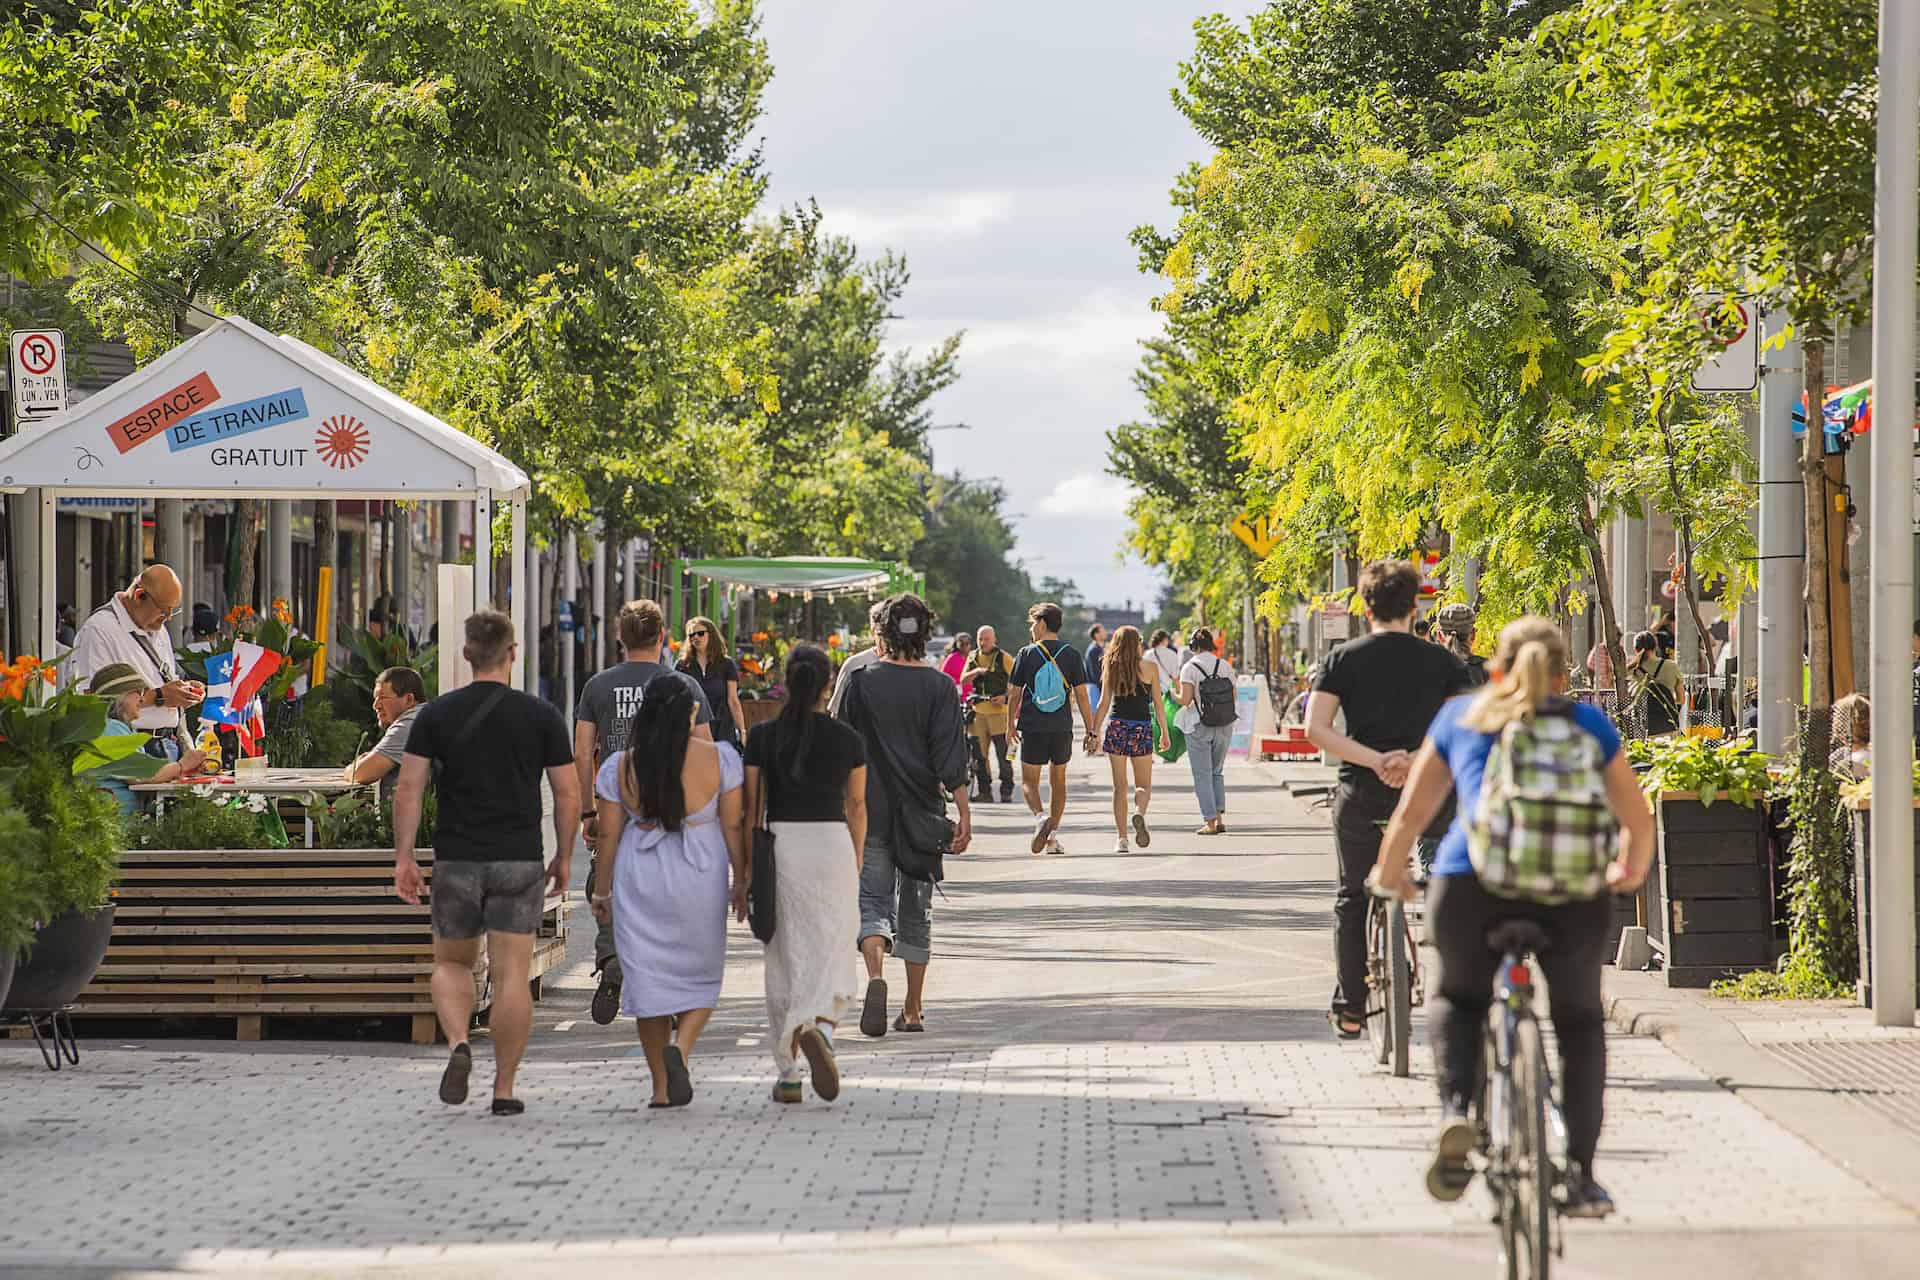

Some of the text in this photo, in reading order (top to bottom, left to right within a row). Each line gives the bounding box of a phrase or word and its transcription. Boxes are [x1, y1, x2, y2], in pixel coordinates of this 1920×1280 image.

[22, 377, 34, 389] 9h
[43, 376, 58, 388] 17h
[21, 389, 36, 402] LUN
[44, 389, 60, 401] VEN
[122, 385, 204, 442] ESPACE
[174, 397, 299, 445] DE TRAVAIL
[210, 447, 309, 467] GRATUIT
[613, 686, 647, 702] TRA
